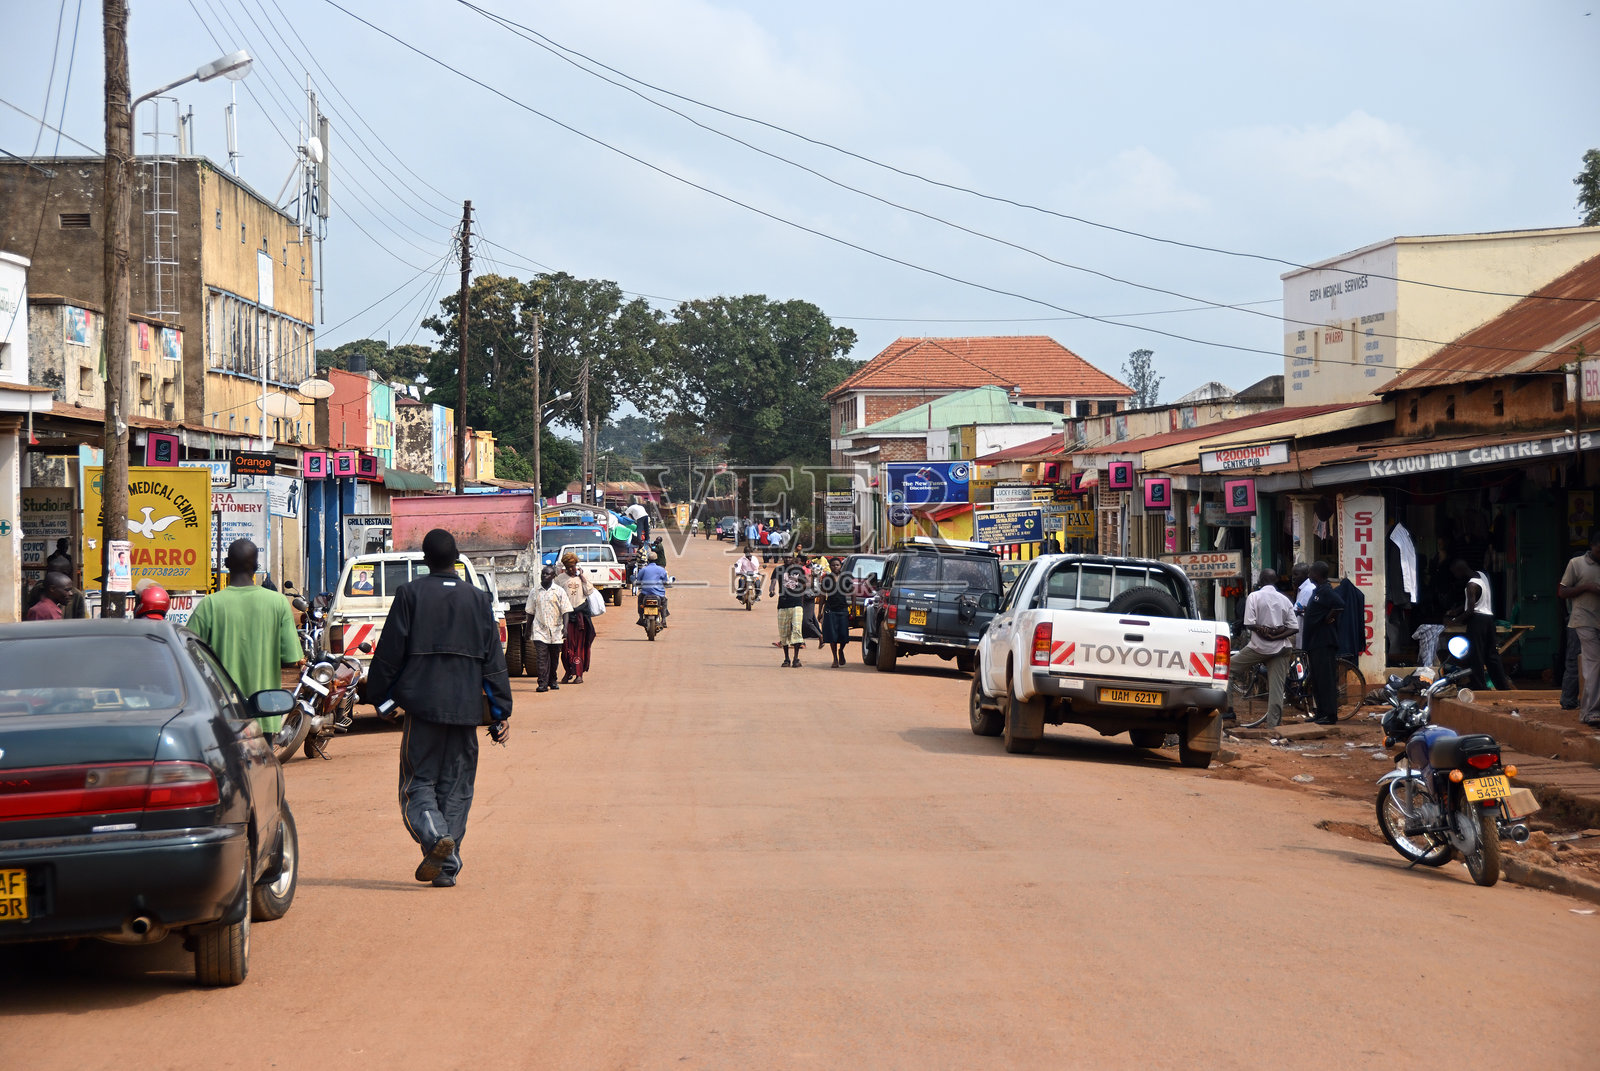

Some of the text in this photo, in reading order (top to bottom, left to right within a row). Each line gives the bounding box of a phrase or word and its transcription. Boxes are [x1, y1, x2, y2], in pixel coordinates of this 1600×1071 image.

[1322, 282, 1343, 299] MEDICAL
[1344, 273, 1369, 294] SERVICES
[1468, 439, 1543, 464] CENTRE
[1551, 432, 1593, 453] PUB
[235, 456, 272, 468] Orange
[1223, 457, 1261, 469] CENTRE PUB
[127, 481, 175, 501] MEDICAL
[173, 494, 199, 529] CENTRE
[348, 518, 364, 526] GRILL
[1066, 512, 1090, 526] FAX
[1354, 511, 1374, 587] SHINE
[23, 552, 41, 562] DVD
[141, 567, 191, 577] 077382237
[1080, 643, 1186, 670] TOYOTA
[1111, 690, 1158, 704] UAM 621Y
[1479, 776, 1503, 788] UDN
[1476, 786, 1507, 799] 545H
